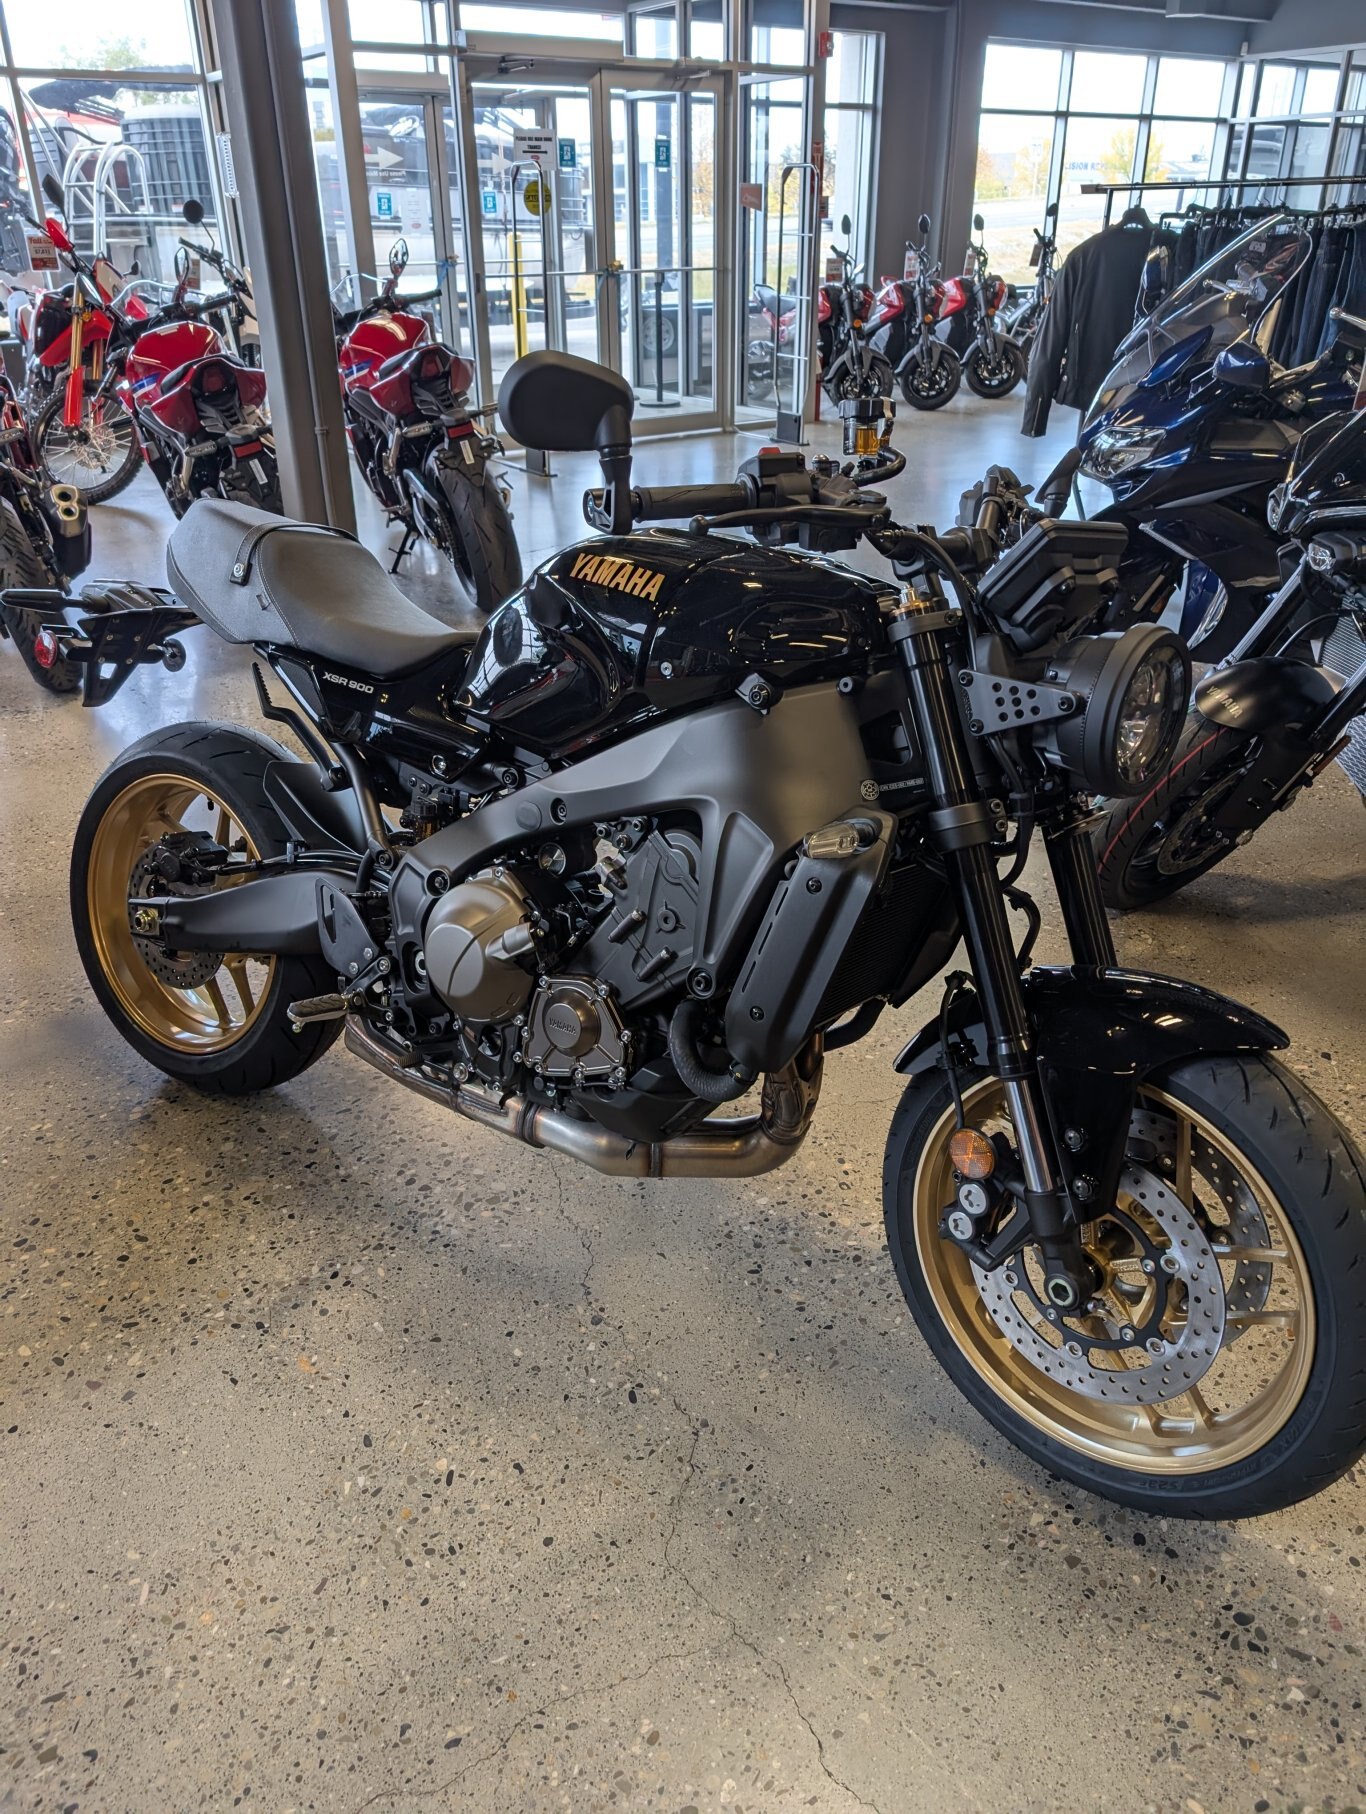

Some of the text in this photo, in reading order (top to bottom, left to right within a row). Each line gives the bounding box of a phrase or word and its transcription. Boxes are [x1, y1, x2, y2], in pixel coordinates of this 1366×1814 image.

[569, 552, 665, 602] YAMAHA
[322, 671, 375, 694] XSR 900
[1206, 685, 1243, 719] YAMAHA
[549, 1017, 577, 1034] YAMAHA
